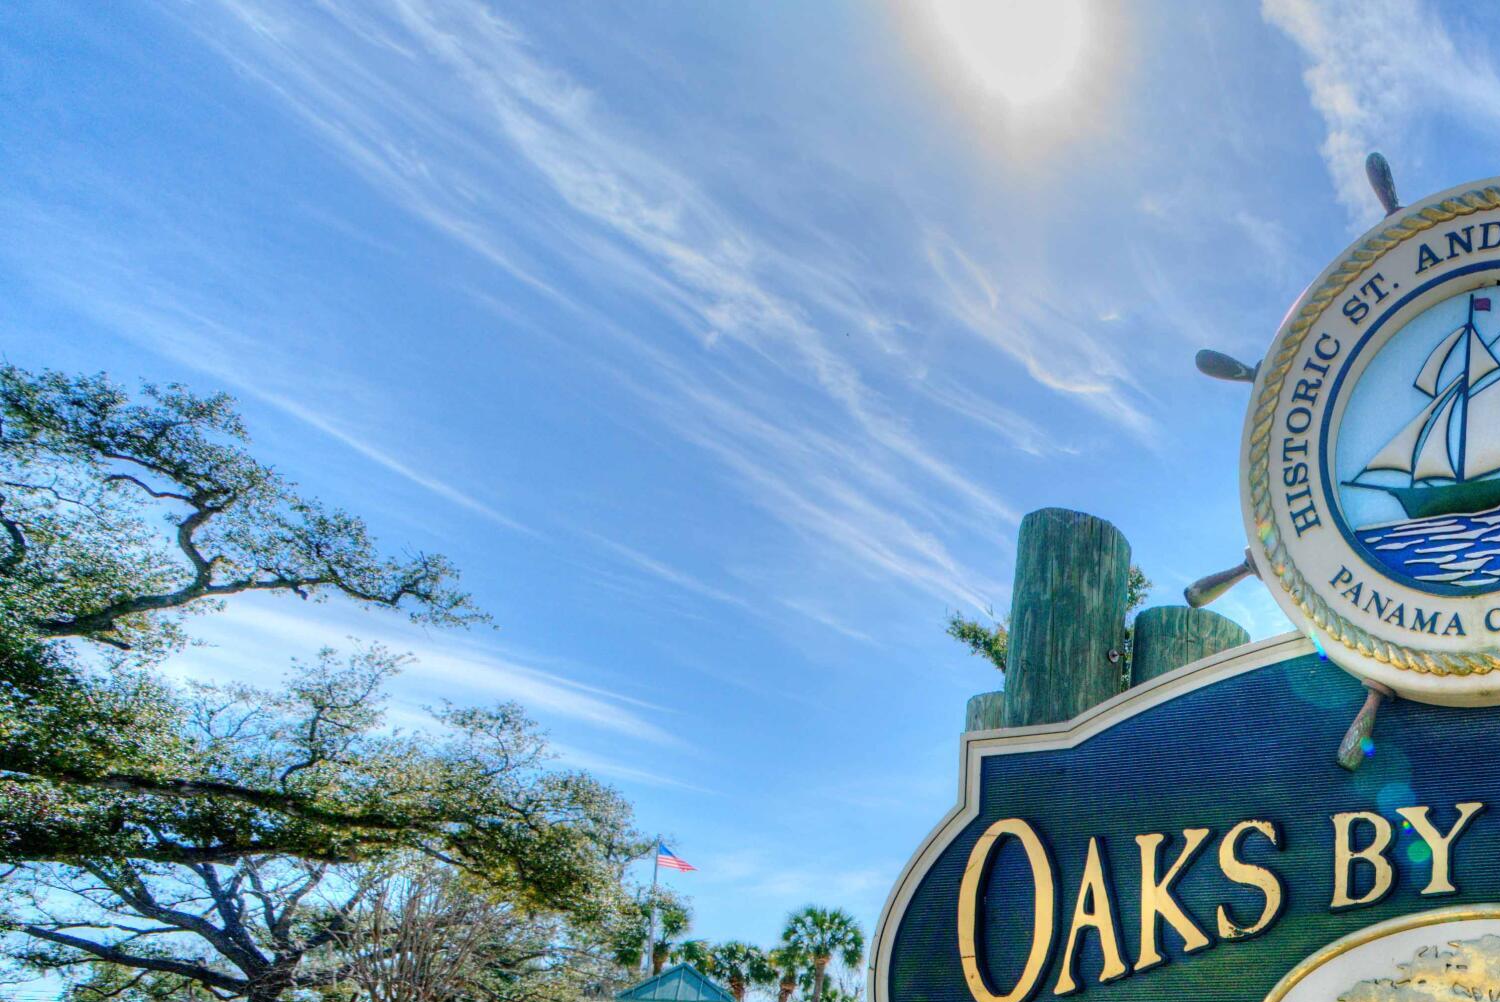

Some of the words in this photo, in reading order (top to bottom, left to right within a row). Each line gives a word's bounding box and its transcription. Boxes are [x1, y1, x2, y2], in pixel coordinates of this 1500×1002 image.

[1282, 332, 1341, 538] HISTORIC
[1342, 273, 1399, 326] ST.
[1328, 564, 1467, 637] PANAMA
[1330, 802, 1486, 909] BY
